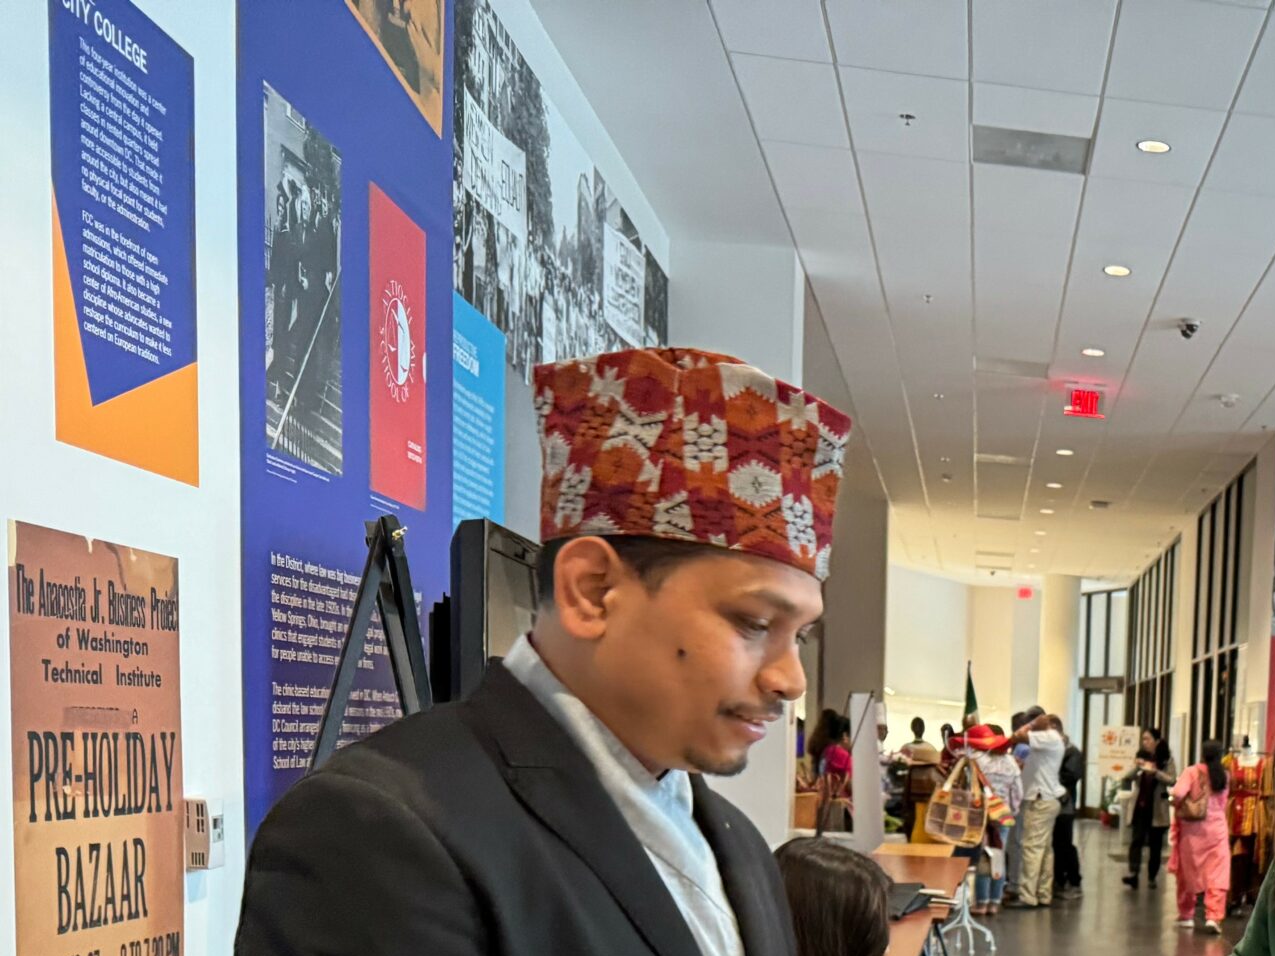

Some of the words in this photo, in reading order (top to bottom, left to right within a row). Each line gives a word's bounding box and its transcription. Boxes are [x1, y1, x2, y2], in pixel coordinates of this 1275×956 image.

[94, 10, 148, 74] COLLEGE
[82, 210, 93, 226] FCC
[120, 233, 139, 253] forefront
[82, 227, 111, 254] admissions,
[127, 253, 144, 271] offered
[145, 263, 167, 284] immediate
[82, 242, 114, 269] matriculation
[122, 264, 134, 280] those
[136, 272, 145, 286] with
[150, 280, 159, 296] high
[83, 257, 99, 276] school
[101, 267, 121, 290] diploma.
[127, 281, 136, 295] also
[137, 287, 155, 306] became
[83, 273, 99, 291] center
[107, 285, 139, 312] Afro-American
[140, 303, 157, 322] studies,
[83, 288, 106, 312] discipline
[124, 309, 147, 330] advocates
[149, 322, 164, 339] wanted
[83, 304, 103, 326] reshape
[114, 319, 138, 340] curriculum
[84, 320, 105, 340] centered
[114, 334, 136, 356] European
[137, 345, 159, 364] traditions.
[1071, 390, 1099, 416] EXIT
[285, 555, 303, 572] District,
[16, 563, 34, 614] The
[38, 568, 87, 622] Anacostia
[90, 577, 105, 624] Jr.
[107, 580, 146, 629] Business
[271, 608, 287, 622] Yellow
[56, 622, 70, 651] of
[76, 626, 148, 661] Washington
[41, 656, 102, 688] Technical
[116, 665, 161, 693] Institute
[132, 708, 137, 724] A
[27, 726, 176, 824] PRE-HOLIDAY
[273, 756, 290, 768] School
[55, 837, 148, 937] BAZAAR
